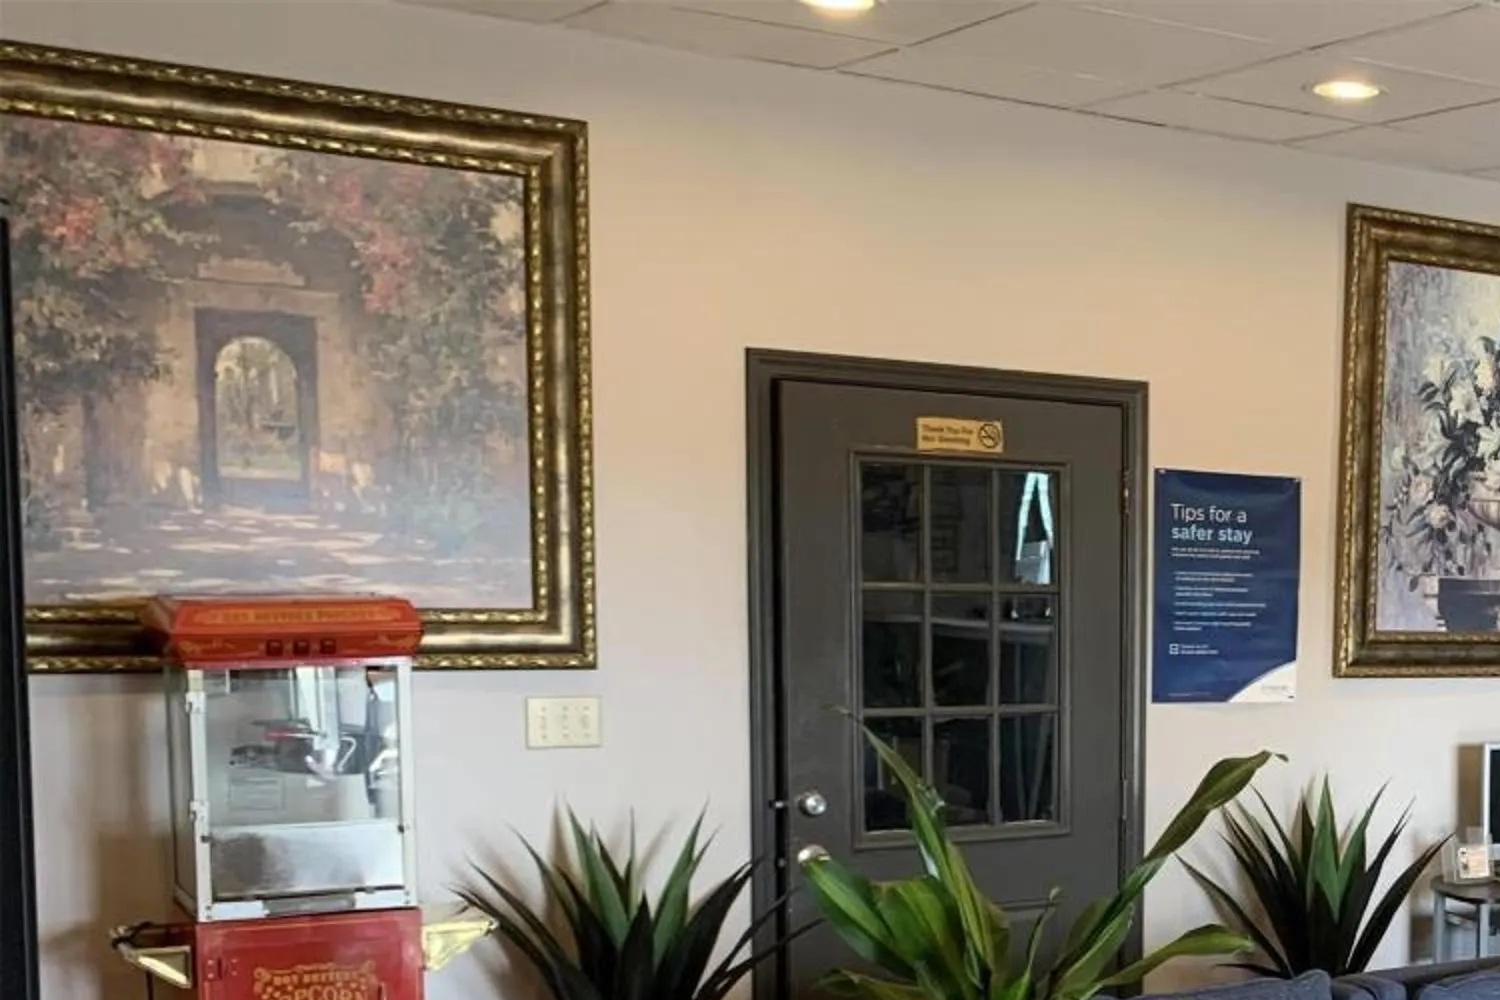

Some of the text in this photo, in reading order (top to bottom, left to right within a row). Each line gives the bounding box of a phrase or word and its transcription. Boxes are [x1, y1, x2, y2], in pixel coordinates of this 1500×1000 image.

[1170, 503, 1247, 523] Tips for a
[1171, 524, 1253, 545] safer stay
